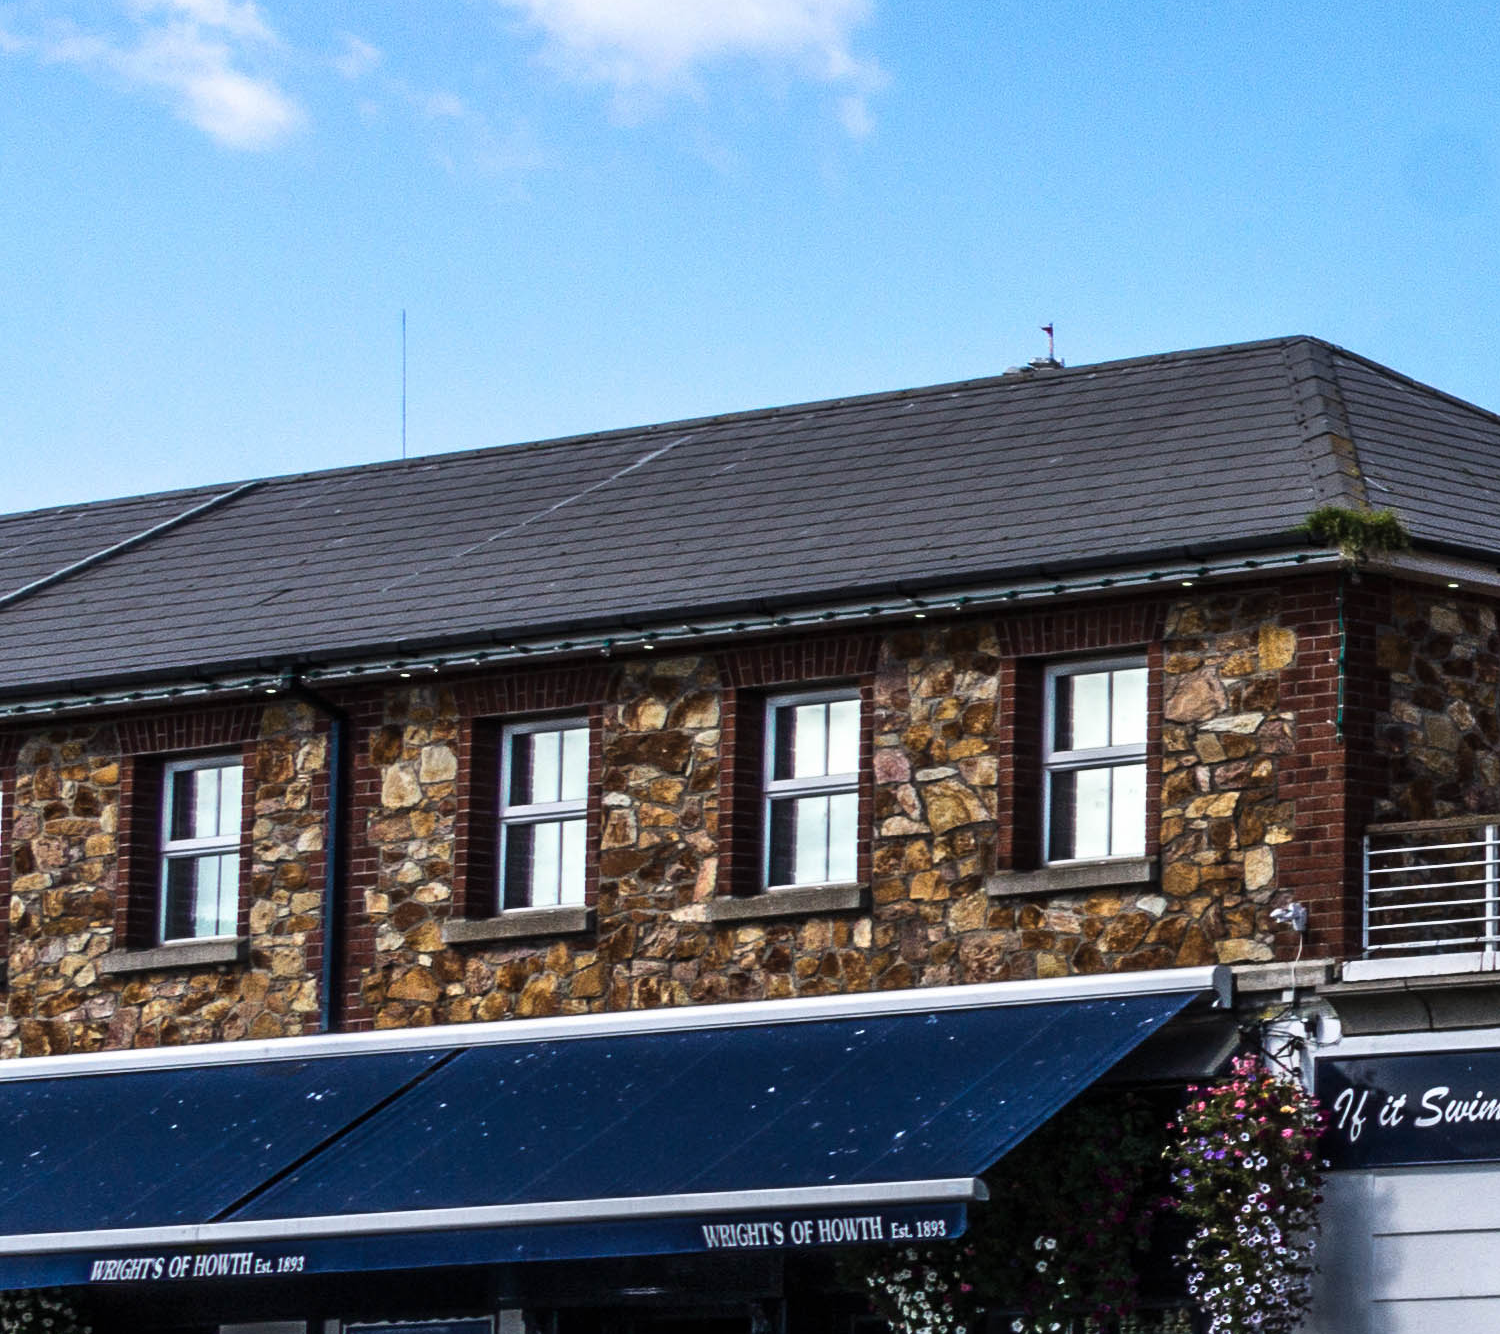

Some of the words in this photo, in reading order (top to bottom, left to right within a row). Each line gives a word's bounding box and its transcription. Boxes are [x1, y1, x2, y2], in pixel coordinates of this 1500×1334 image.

[1334, 1088, 1369, 1142] If
[1379, 1086, 1408, 1127] it
[702, 1222, 784, 1248] WRIGHT'S
[790, 1220, 814, 1244] OF
[818, 1216, 884, 1242] HOWTH
[891, 1222, 913, 1239] Est.
[917, 1220, 947, 1237] 1893
[90, 1257, 165, 1282] WRIGHT'S
[168, 1255, 192, 1278] OF
[193, 1252, 254, 1277] HOWTH
[254, 1258, 274, 1274] Est.
[277, 1256, 305, 1273] 1893
